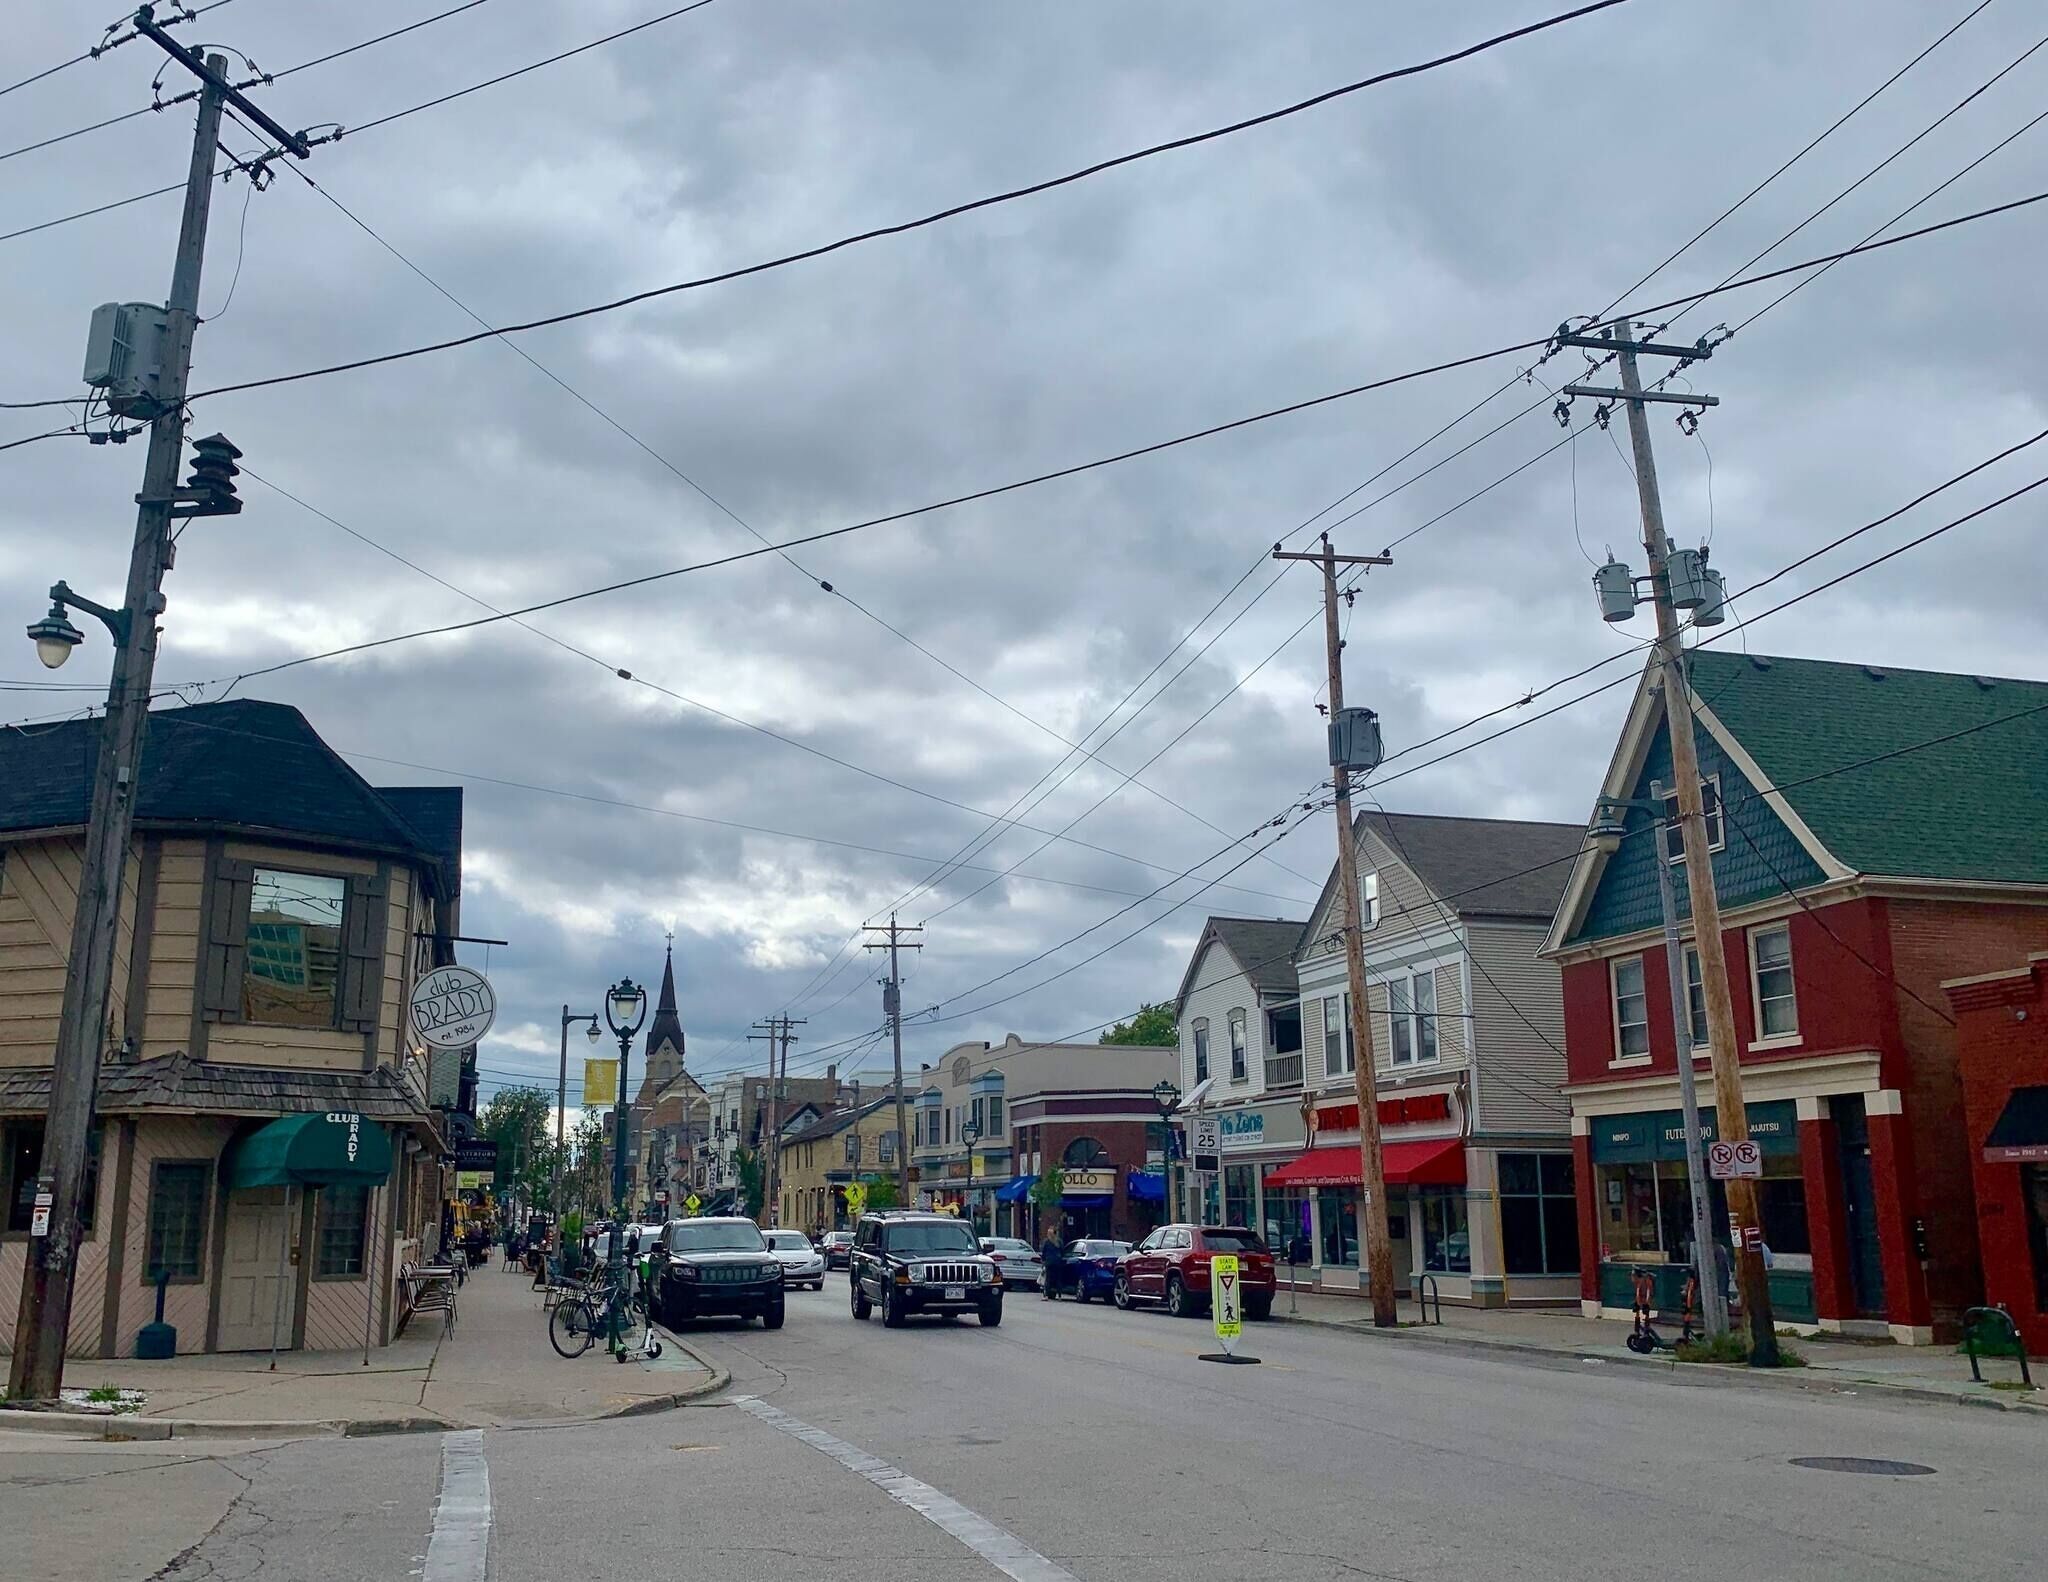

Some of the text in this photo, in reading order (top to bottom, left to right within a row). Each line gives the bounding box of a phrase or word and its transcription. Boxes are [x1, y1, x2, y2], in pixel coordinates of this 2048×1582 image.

[430, 973, 462, 996] club
[414, 985, 485, 1031] BRADY
[455, 1023, 475, 1037] 1984
[326, 1112, 360, 1124] CLUB
[347, 1114, 360, 1162] BRADY
[1198, 1134, 1215, 1147] 25
[1665, 1128, 1686, 1140] FUTE
